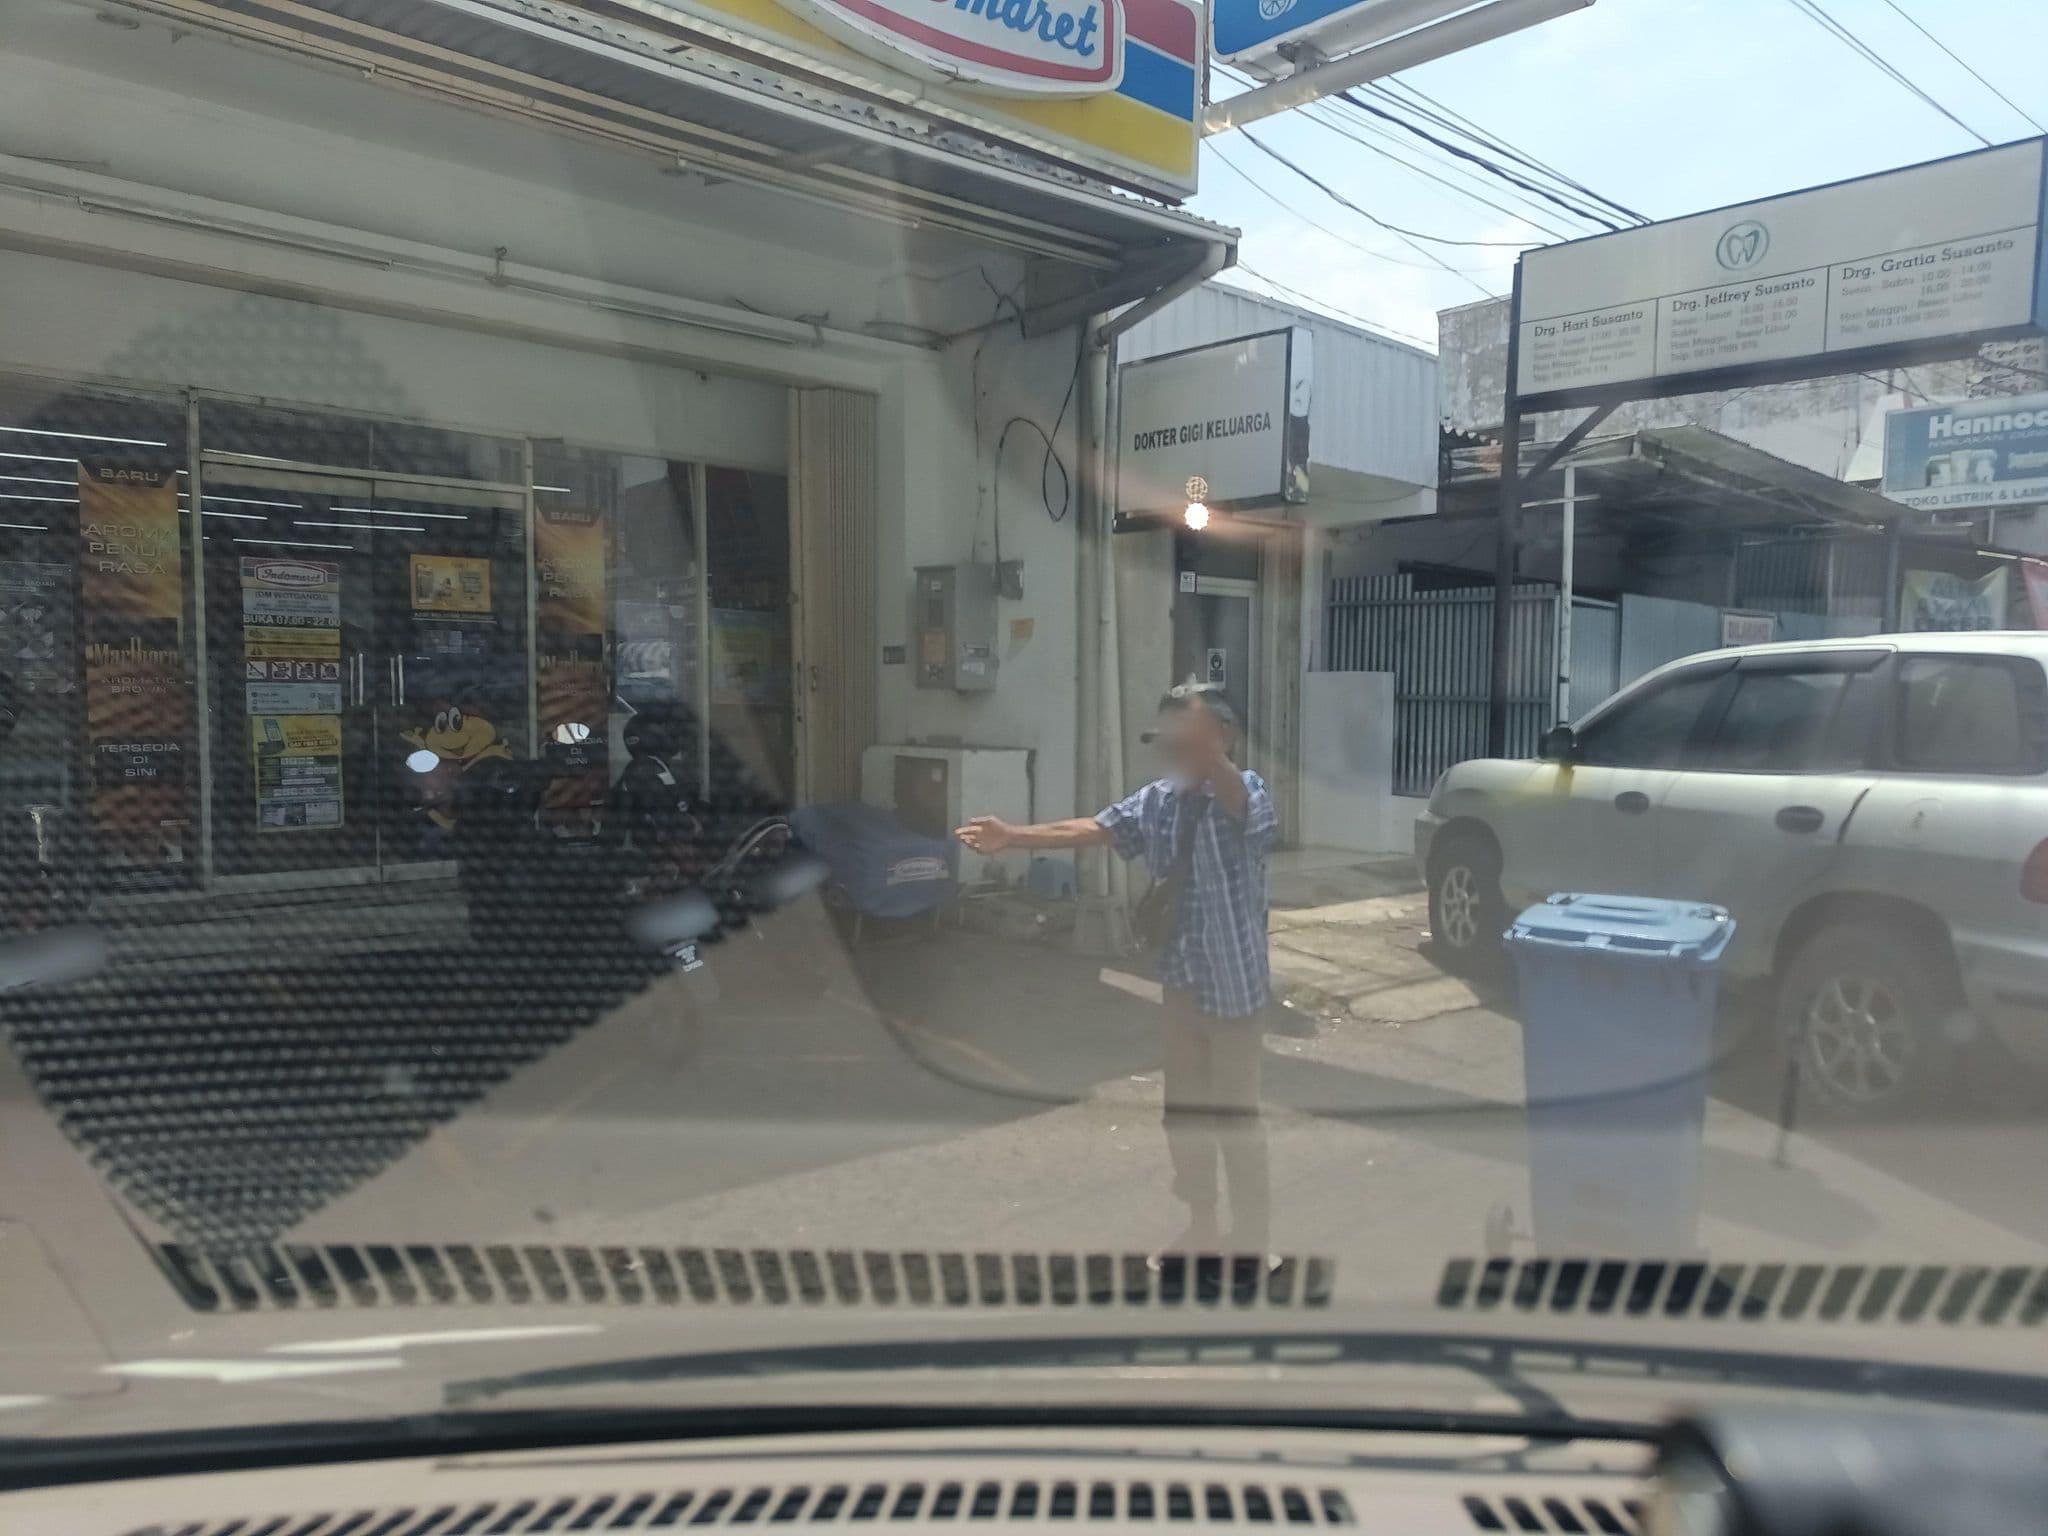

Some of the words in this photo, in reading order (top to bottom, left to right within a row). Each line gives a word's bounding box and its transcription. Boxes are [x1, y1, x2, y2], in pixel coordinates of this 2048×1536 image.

[1842, 266, 1876, 280] Drg.
[1881, 254, 1936, 272] Gratia
[1941, 239, 2014, 261] Susanto
[1672, 300, 1701, 312] Drg.
[1705, 290, 1750, 308] Jeffrey
[1755, 277, 1815, 297] Susanto
[1534, 326, 1560, 337] Drg.
[1562, 319, 1589, 333] Hari
[1592, 311, 1644, 327] Susanto
[1134, 427, 1177, 452] DOKTER
[1179, 423, 1204, 445] GIGI
[1206, 412, 1272, 441] KELUARGA
[100, 468, 159, 482] BARU
[1904, 495, 1939, 507] TOKO
[1943, 490, 1994, 504] LISTRIK
[85, 523, 177, 539] AROMA
[99, 561, 168, 575] RASA
[243, 614, 274, 624] BUKA
[94, 636, 179, 665] Marlboro
[98, 743, 181, 753] TERSEDIA
[132, 755, 149, 765] DI
[124, 768, 157, 777] SINI
